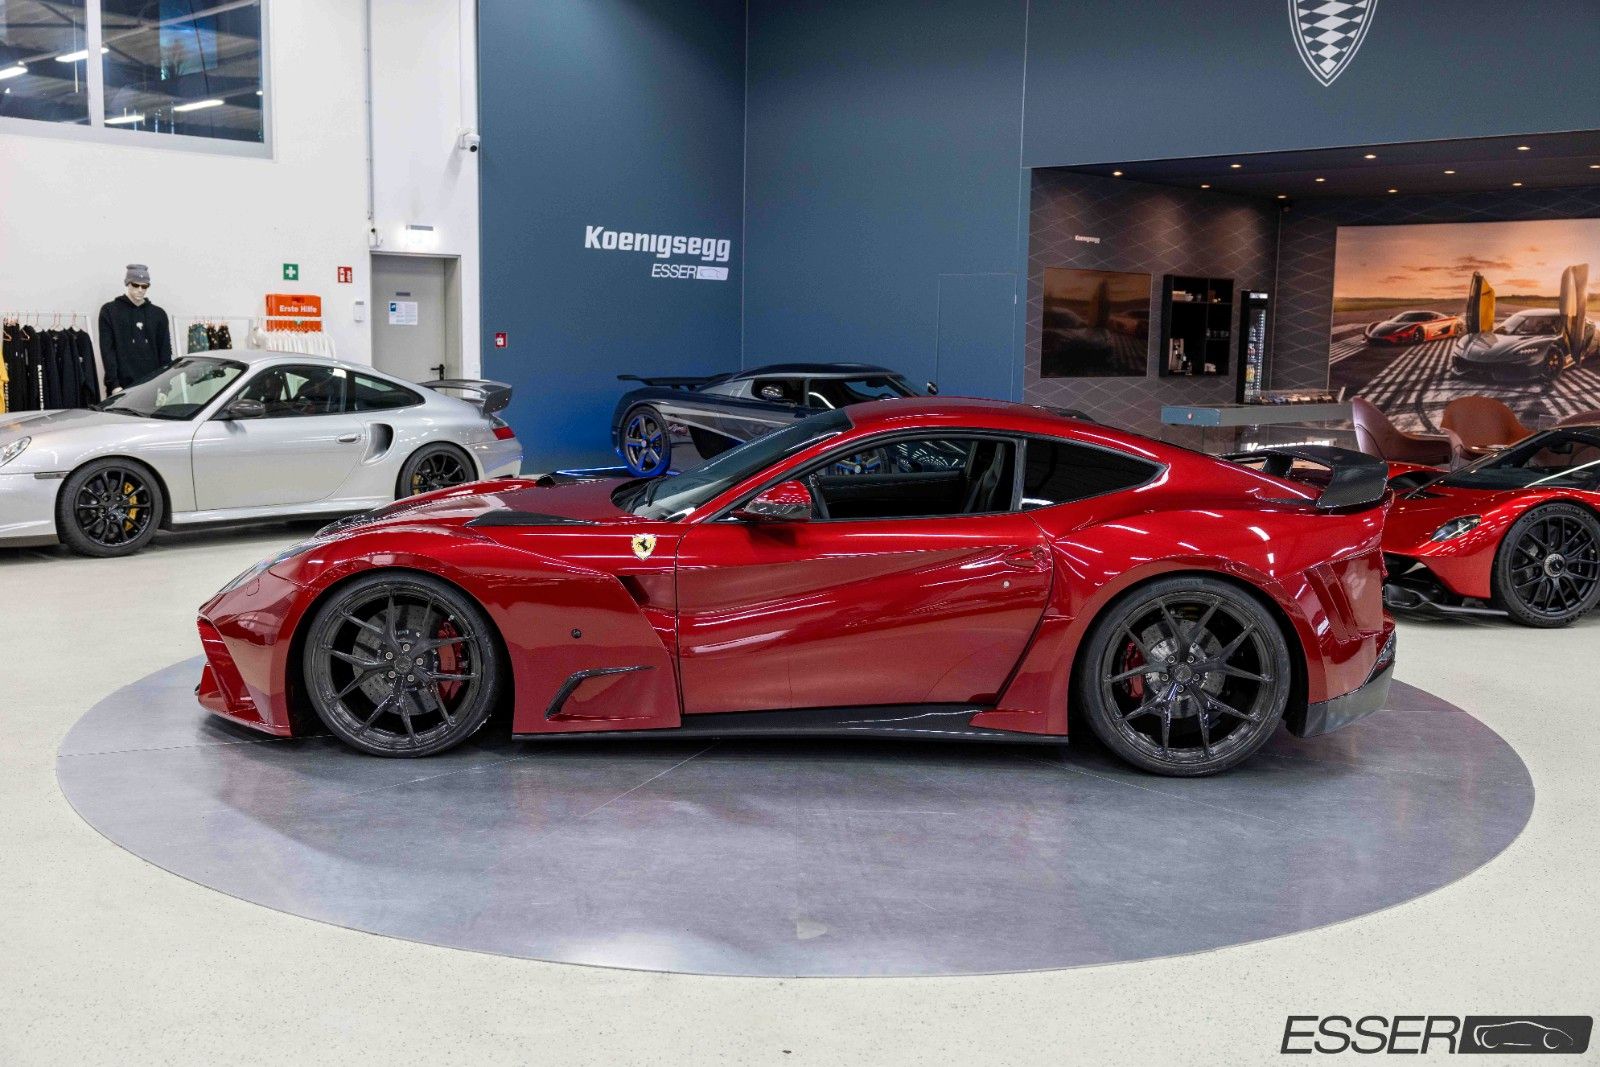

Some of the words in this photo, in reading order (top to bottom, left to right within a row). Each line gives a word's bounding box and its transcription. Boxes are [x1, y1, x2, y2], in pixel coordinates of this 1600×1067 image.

[585, 225, 731, 262] Koenigsegg
[651, 263, 697, 279] ESSER
[279, 304, 299, 313] Erste
[300, 305, 318, 313] Hilfe
